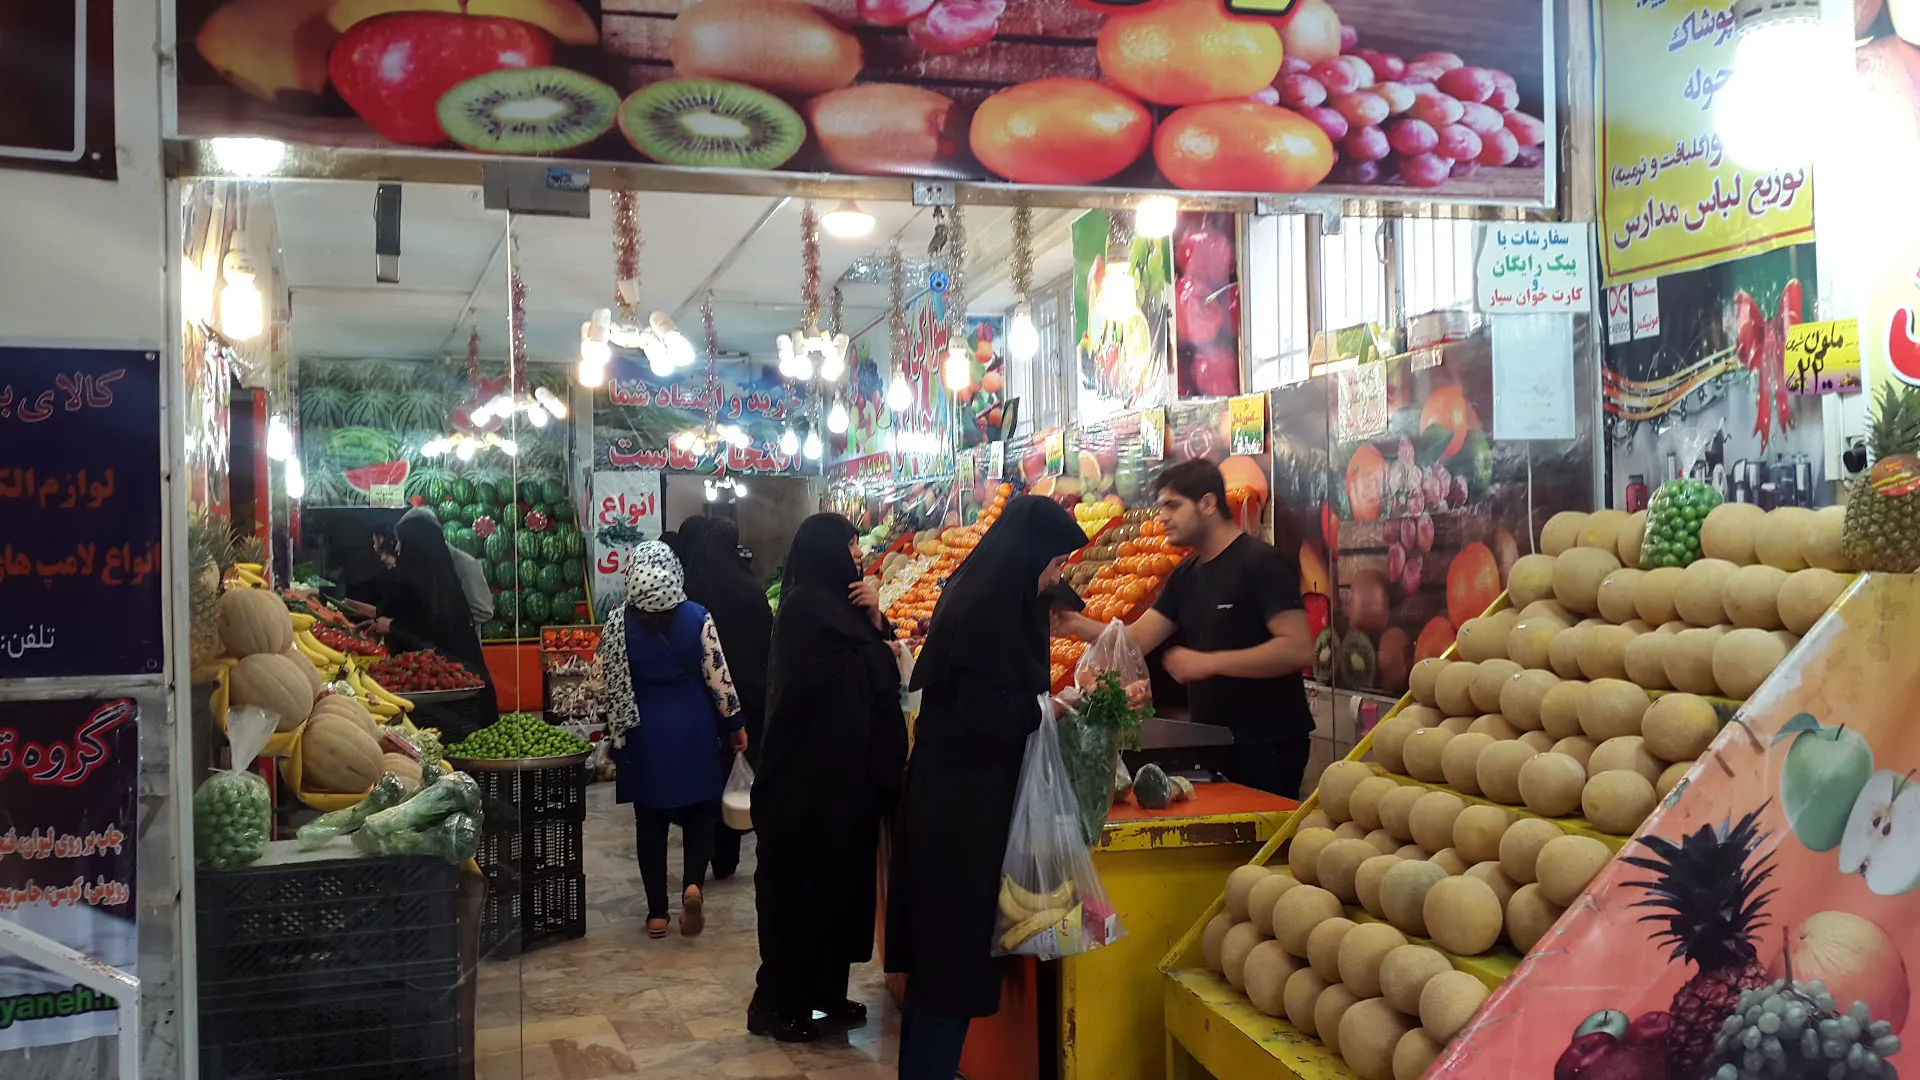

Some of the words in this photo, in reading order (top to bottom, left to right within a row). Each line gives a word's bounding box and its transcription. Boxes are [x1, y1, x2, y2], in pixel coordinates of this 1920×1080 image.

[1650, 158, 1658, 179] و
[1684, 174, 1742, 231] لباس
[1614, 199, 1679, 249] مدارس
[1497, 229, 1507, 250] با
[1492, 253, 1543, 277] رایگان
[1546, 253, 1577, 277] پیک
[1490, 288, 1512, 306] سیار
[1516, 286, 1548, 306] خوان
[1532, 278, 1539, 291] و
[1552, 286, 1583, 306] کارت
[17, 368, 126, 422] کالای
[608, 378, 651, 406] شما
[727, 393, 742, 419] و
[39, 467, 115, 508] لوازم
[598, 492, 655, 526] انواع
[37, 543, 96, 589] لامپ
[101, 541, 161, 585] انواع
[23, 701, 131, 782] گروه
[55, 834, 82, 858] روی
[82, 830, 96, 856] بر
[95, 823, 125, 857] چاپ
